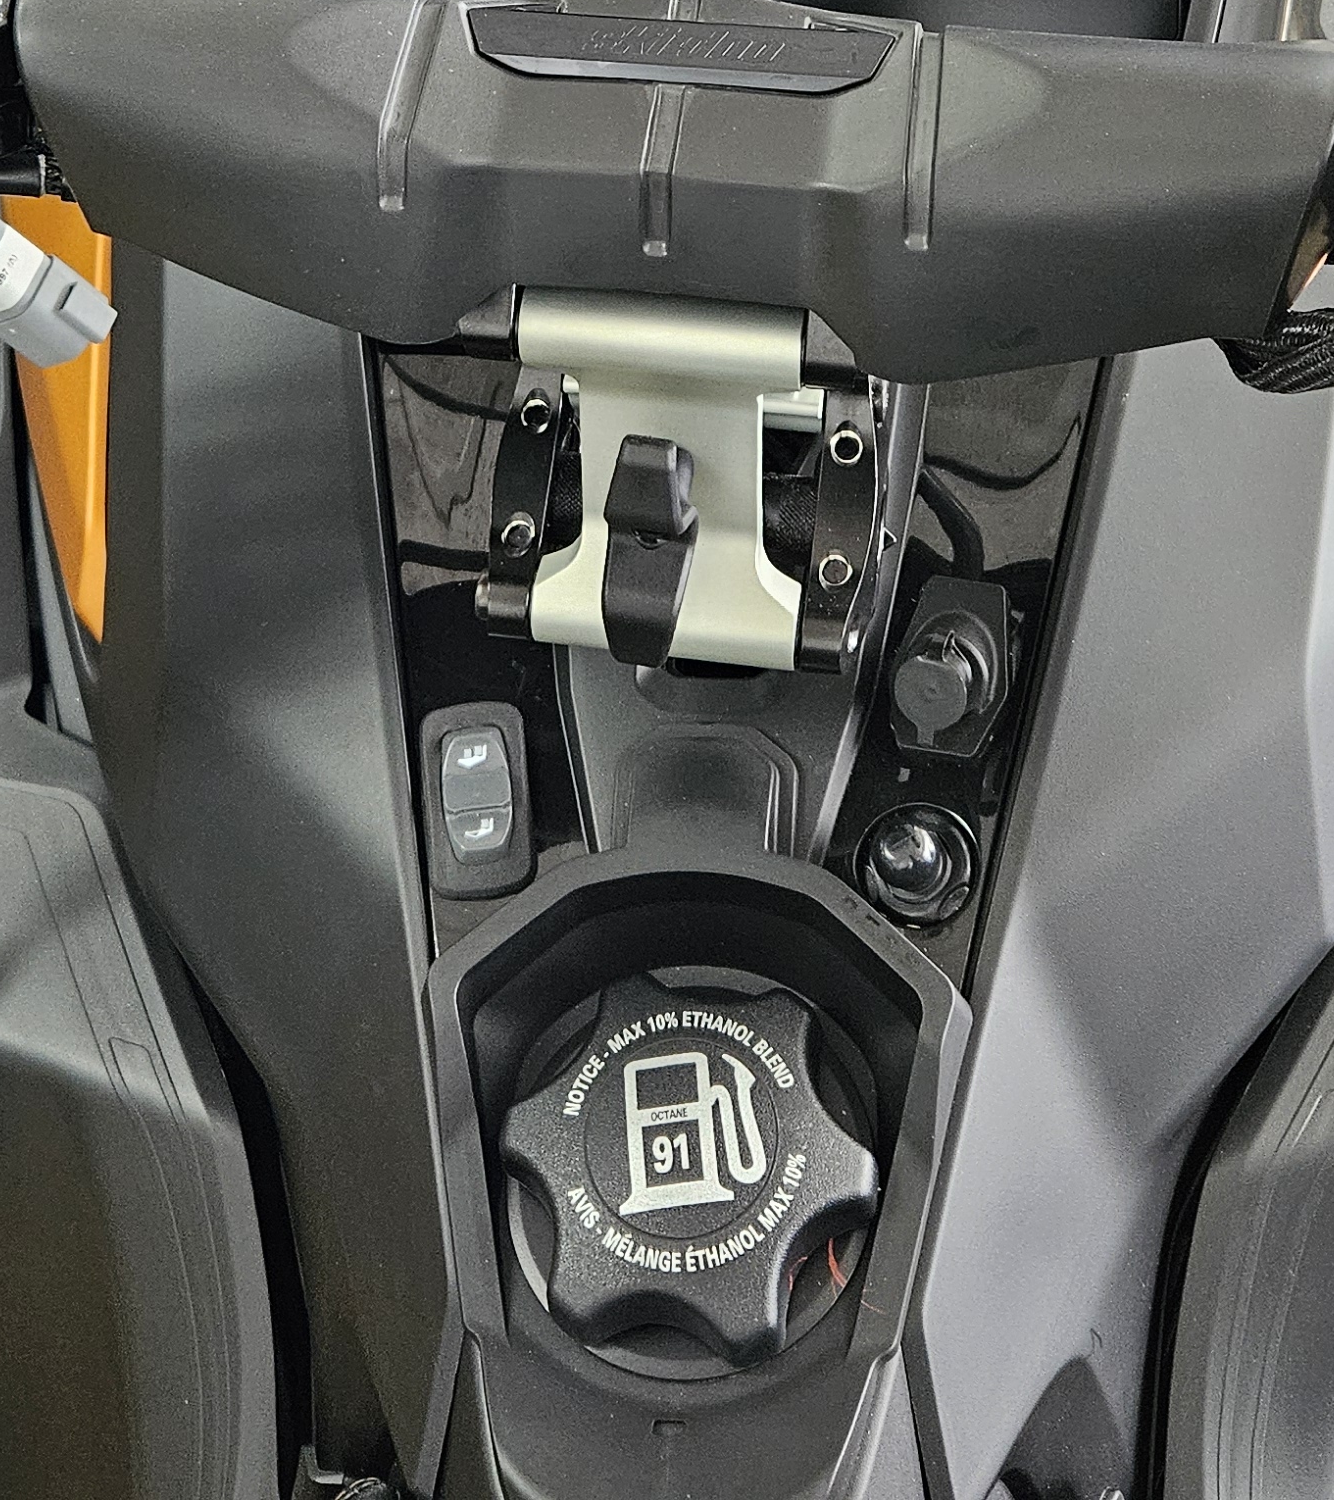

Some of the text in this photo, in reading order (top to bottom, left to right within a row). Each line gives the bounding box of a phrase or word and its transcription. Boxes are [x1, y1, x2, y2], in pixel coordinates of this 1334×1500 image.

[563, 1011, 794, 1116] NOTICE MAX 10% ETHANOL BLEND
[650, 1108, 688, 1121] OCTANE
[652, 1133, 690, 1174] 91
[567, 1152, 806, 1273] AVIS MÉLANGE ÉTHANOL MAX 10%
